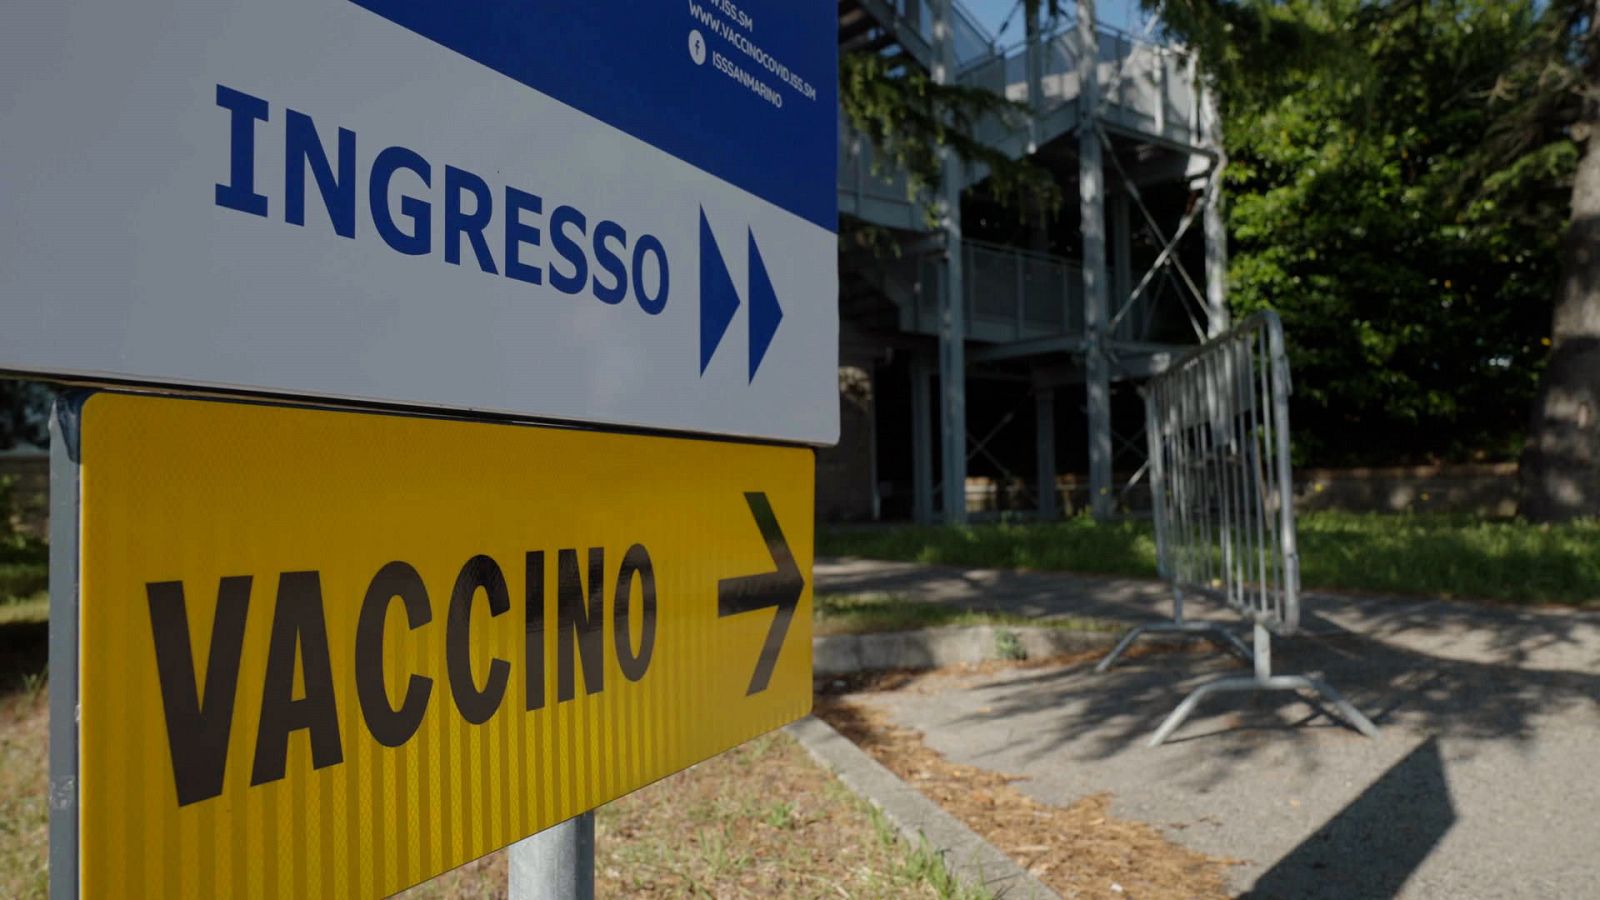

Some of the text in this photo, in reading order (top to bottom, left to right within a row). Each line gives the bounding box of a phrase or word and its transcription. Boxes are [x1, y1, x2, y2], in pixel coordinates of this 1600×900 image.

[689, 0, 816, 101] WWW.VACCINOCOVID.ISS.SM
[712, 50, 782, 108] ISSSANMARINO
[215, 83, 670, 315] INGRESSO
[145, 542, 657, 808] VACCINO
